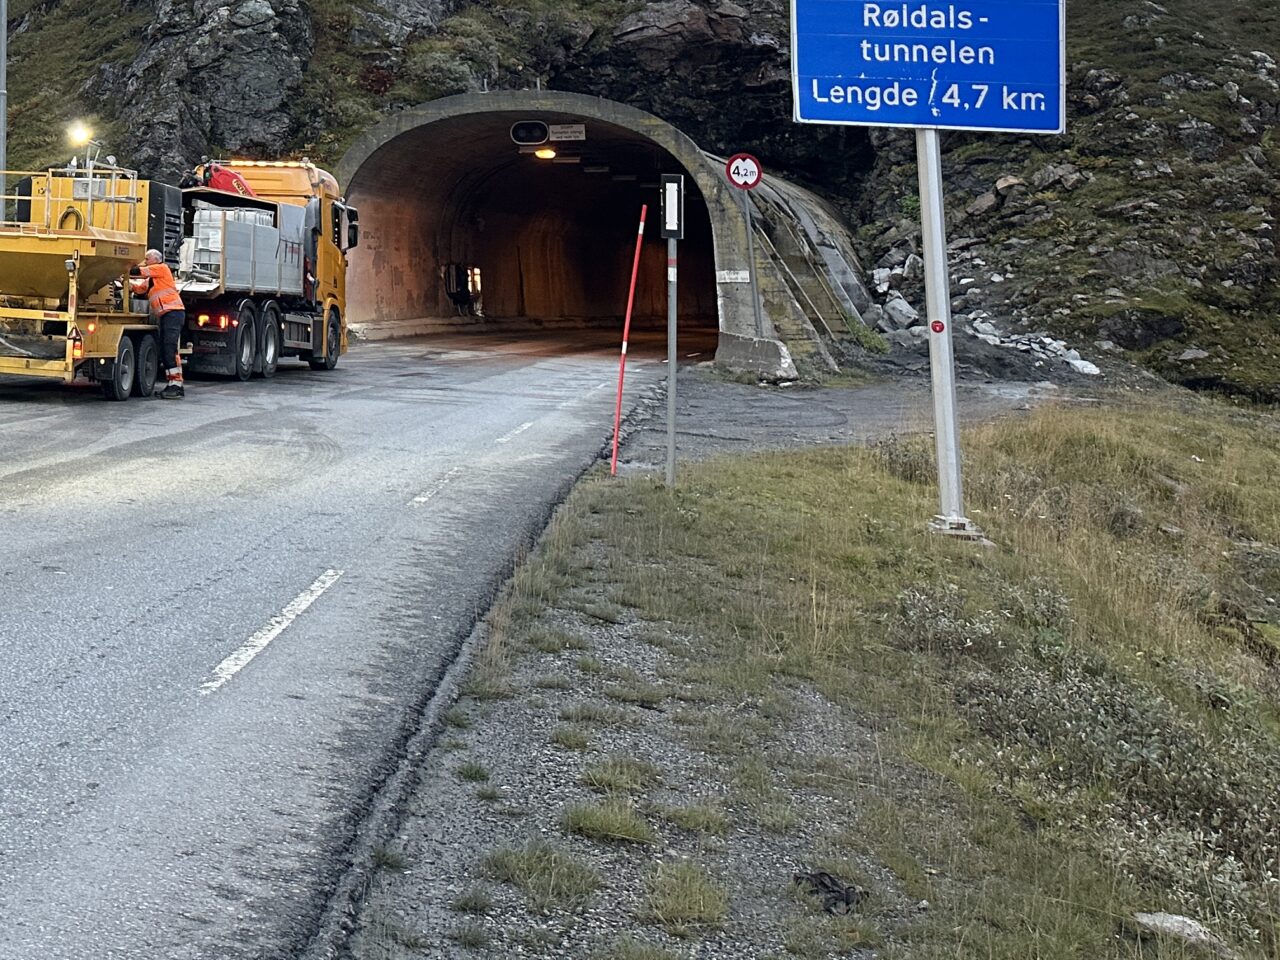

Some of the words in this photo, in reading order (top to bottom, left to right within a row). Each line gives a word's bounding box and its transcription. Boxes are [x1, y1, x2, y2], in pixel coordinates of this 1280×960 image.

[863, 3, 988, 29] Røldals-
[860, 40, 994, 64] tunnelen
[812, 79, 918, 110] Lengde
[942, 84, 989, 111] 4,7
[1002, 86, 1045, 110] km
